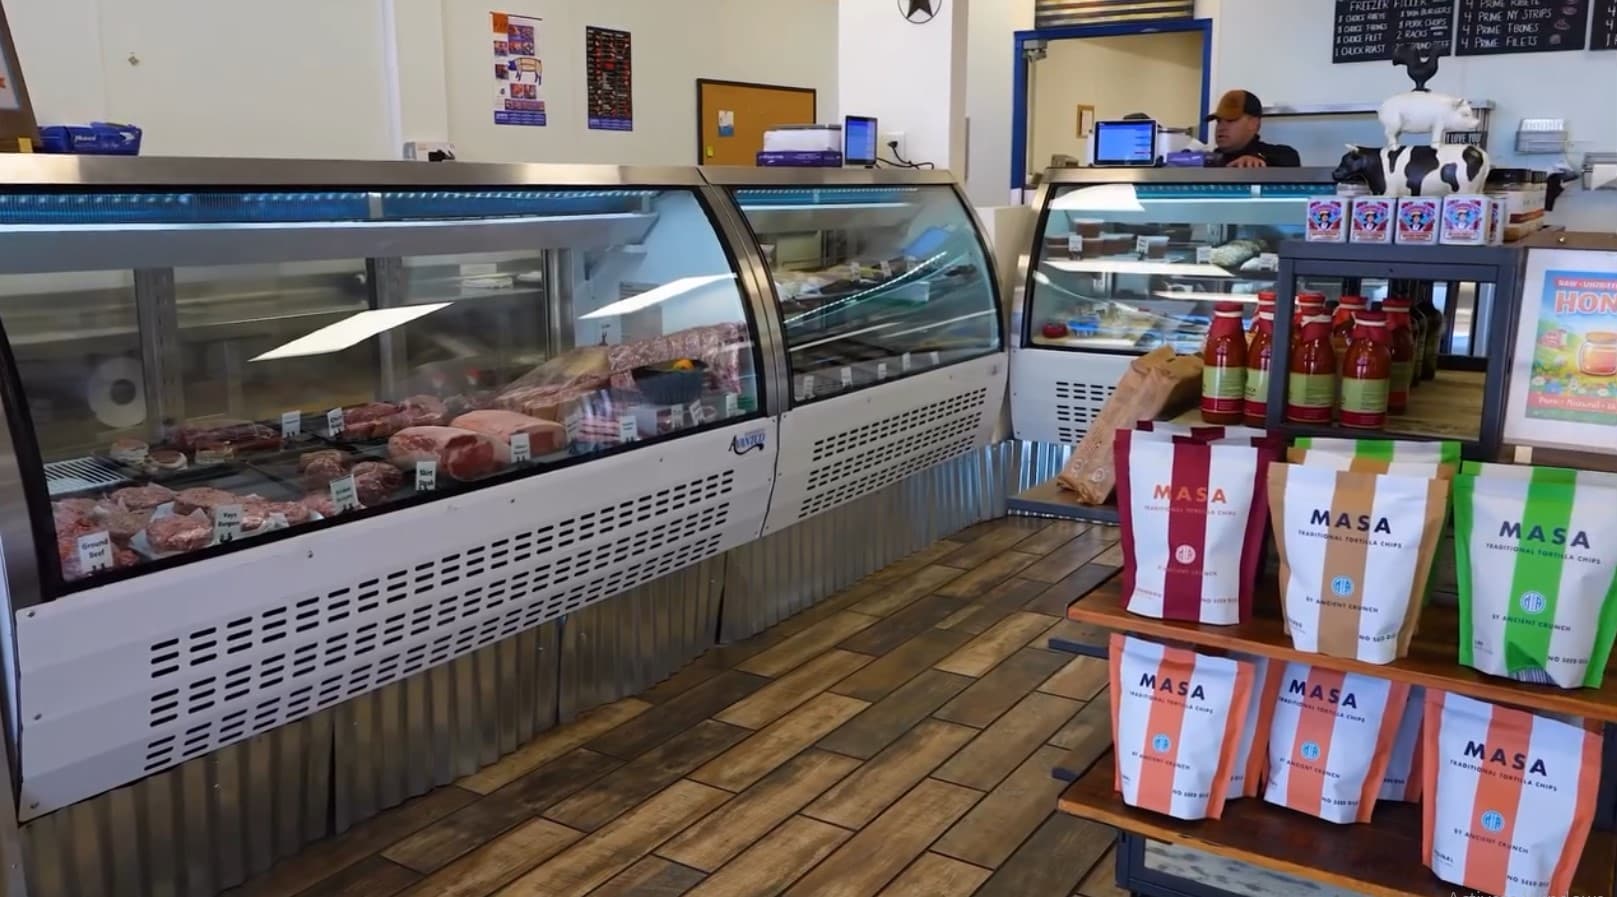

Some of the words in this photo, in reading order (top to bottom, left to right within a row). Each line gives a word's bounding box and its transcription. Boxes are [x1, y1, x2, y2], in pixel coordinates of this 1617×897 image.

[1464, 12, 1472, 23] 4
[1478, 12, 1503, 22] PRIME
[1507, 10, 1518, 20] NY
[1522, 8, 1552, 20] STRIPS
[1608, 6, 1616, 16] 4
[1462, 25, 1470, 35] 4
[1476, 24, 1501, 35] PRIME
[1461, 37, 1469, 48] 4
[1474, 37, 1500, 48] PRIME
[1506, 36, 1539, 47] FILETS
[1554, 290, 1617, 315] HON
[1153, 484, 1227, 504] MASA
[1310, 509, 1391, 534] MASA
[81, 538, 109, 550] Ground
[1298, 530, 1343, 541] TRADITIONAL
[1345, 536, 1378, 546] TORTILLA
[1380, 541, 1402, 549] CHIPS
[1499, 521, 1590, 549] MASA
[88, 548, 105, 559] Beef
[1486, 543, 1535, 556] TRADITIONAL
[1537, 550, 1574, 560] TORTILLA
[1577, 555, 1601, 565] CHIPS
[1502, 615, 1535, 625] ANCIENT
[1538, 621, 1571, 631] CRUNCH
[1139, 673, 1205, 700] MASA
[1288, 679, 1357, 709] MASA
[1464, 740, 1547, 776] MASA
[1449, 759, 1496, 776] TRADITIONAL
[1499, 772, 1532, 785] TORTILLA
[1535, 781, 1557, 792] CHIPS
[1498, 840, 1529, 854] CRUNCH
[1507, 874, 1518, 883] NO
